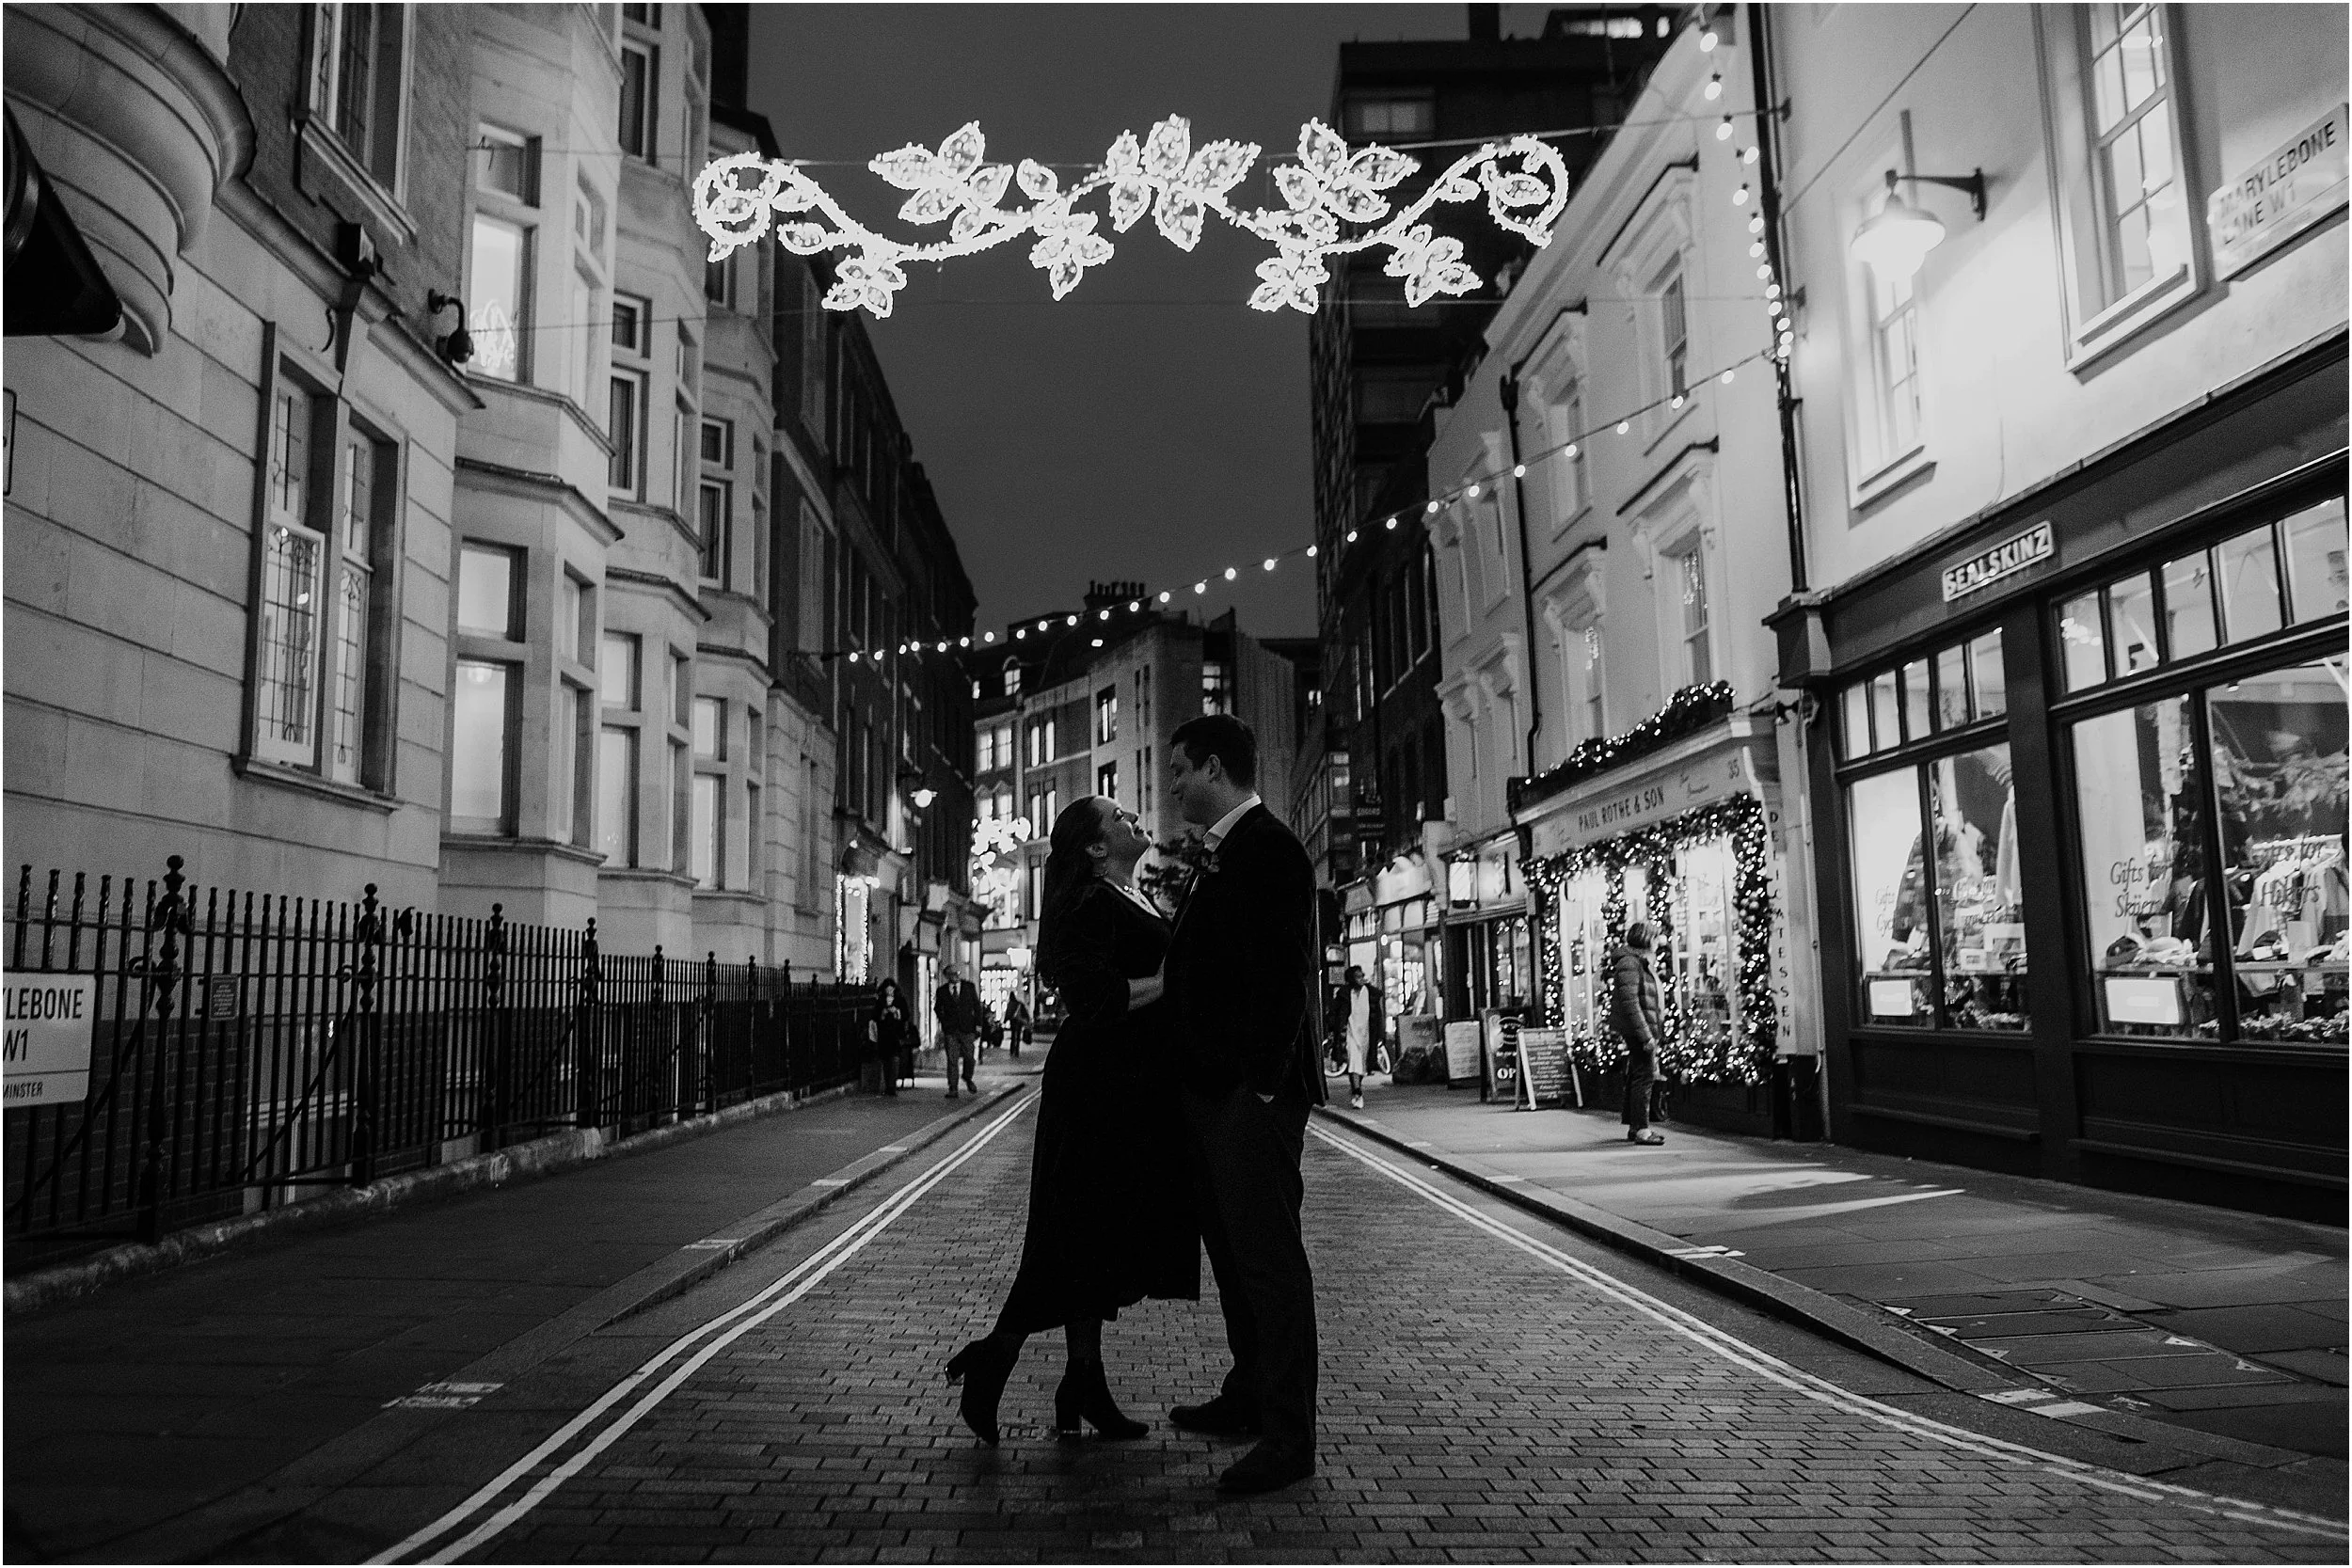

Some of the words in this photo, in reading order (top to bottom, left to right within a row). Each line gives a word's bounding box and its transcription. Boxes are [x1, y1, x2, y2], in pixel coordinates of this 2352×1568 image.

[2218, 119, 2337, 218] MARYLEBONE
[2221, 199, 2265, 247] LANE
[2268, 180, 2296, 213] W1
[1944, 526, 2049, 596] SEALSKINZ
[1578, 810, 1599, 833] PAUL
[1601, 798, 1631, 825] ROTHE
[1633, 794, 1642, 815] &
[1644, 784, 1665, 811] SON
[2110, 856, 2144, 892] Gifts
[1769, 811, 1791, 1038] DELICATESSEN
[3, 988, 84, 1021] LEBONE
[3, 1028, 28, 1061] W1
[1497, 1068, 1517, 1080] OP
